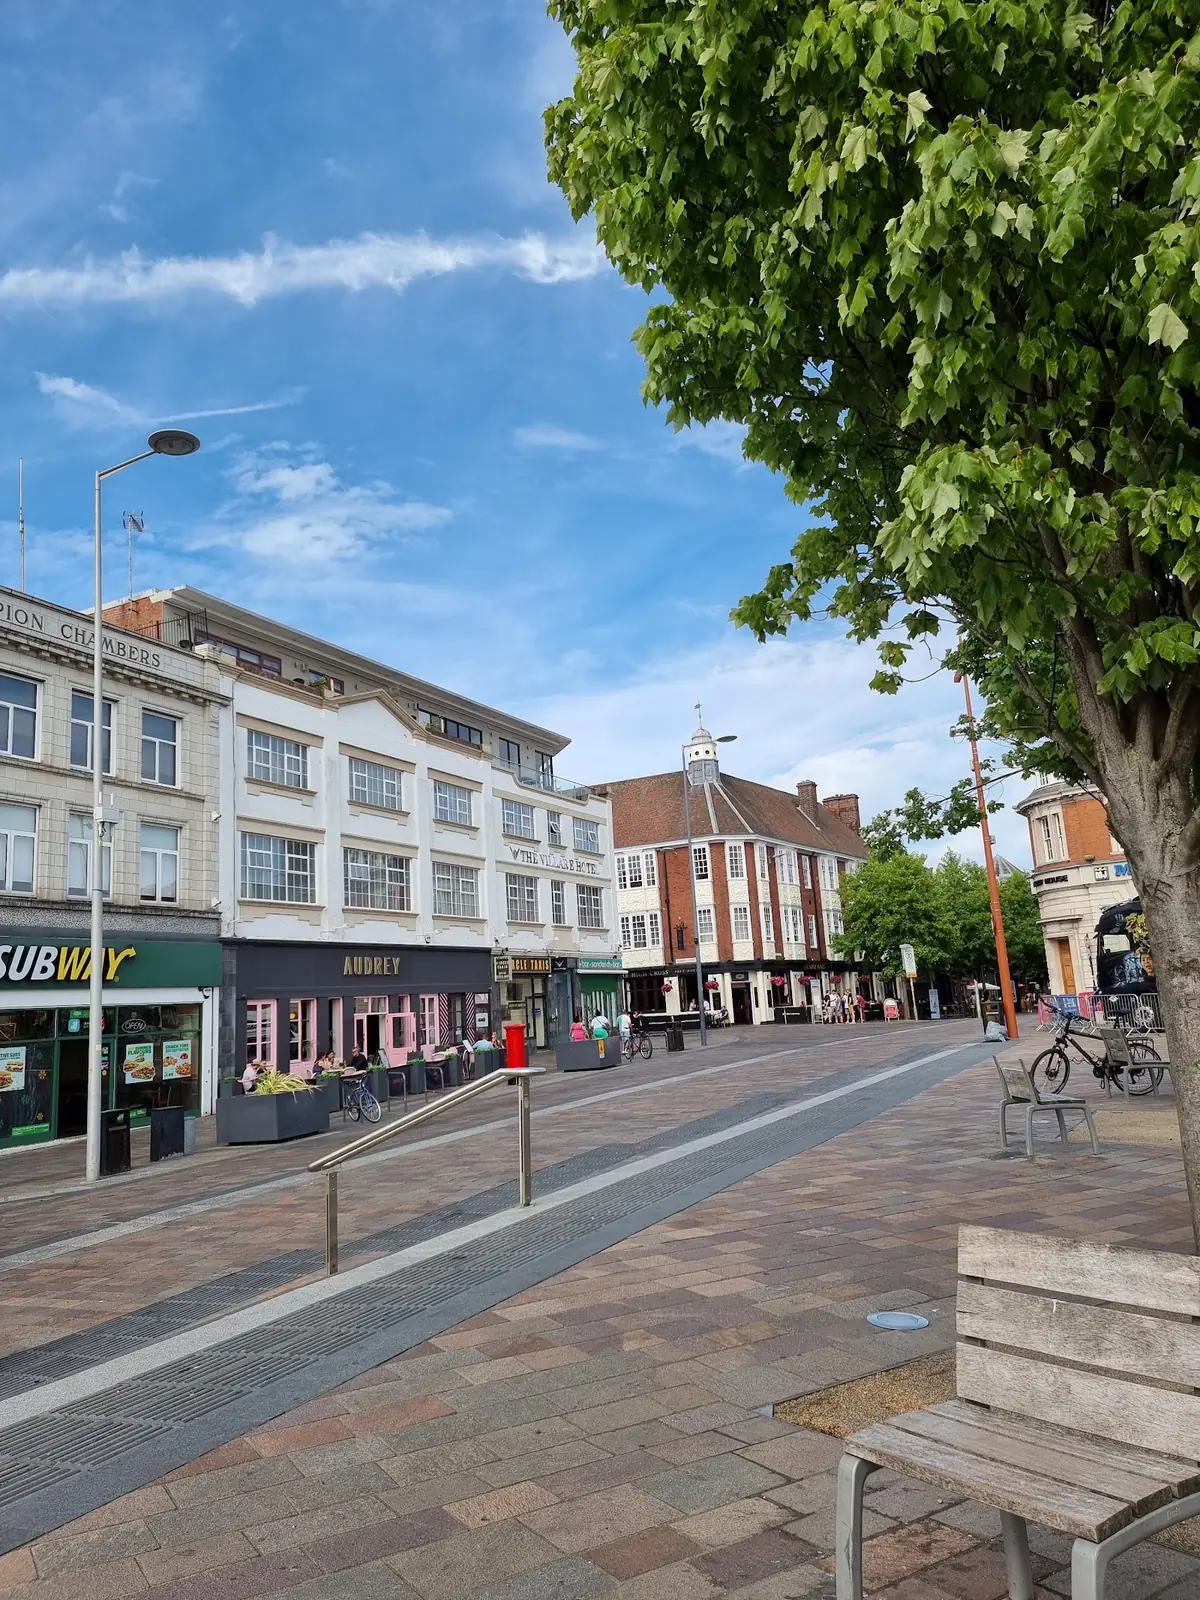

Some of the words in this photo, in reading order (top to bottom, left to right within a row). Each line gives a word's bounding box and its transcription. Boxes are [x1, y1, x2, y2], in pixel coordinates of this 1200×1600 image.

[60, 624, 161, 668] CHAMBERS
[520, 850, 538, 864] THE
[1044, 874, 1068, 885] HOUSE
[343, 956, 400, 975] AUDREY
[530, 959, 549, 970] TAXIS
[124, 1021, 143, 1030] OPEN
